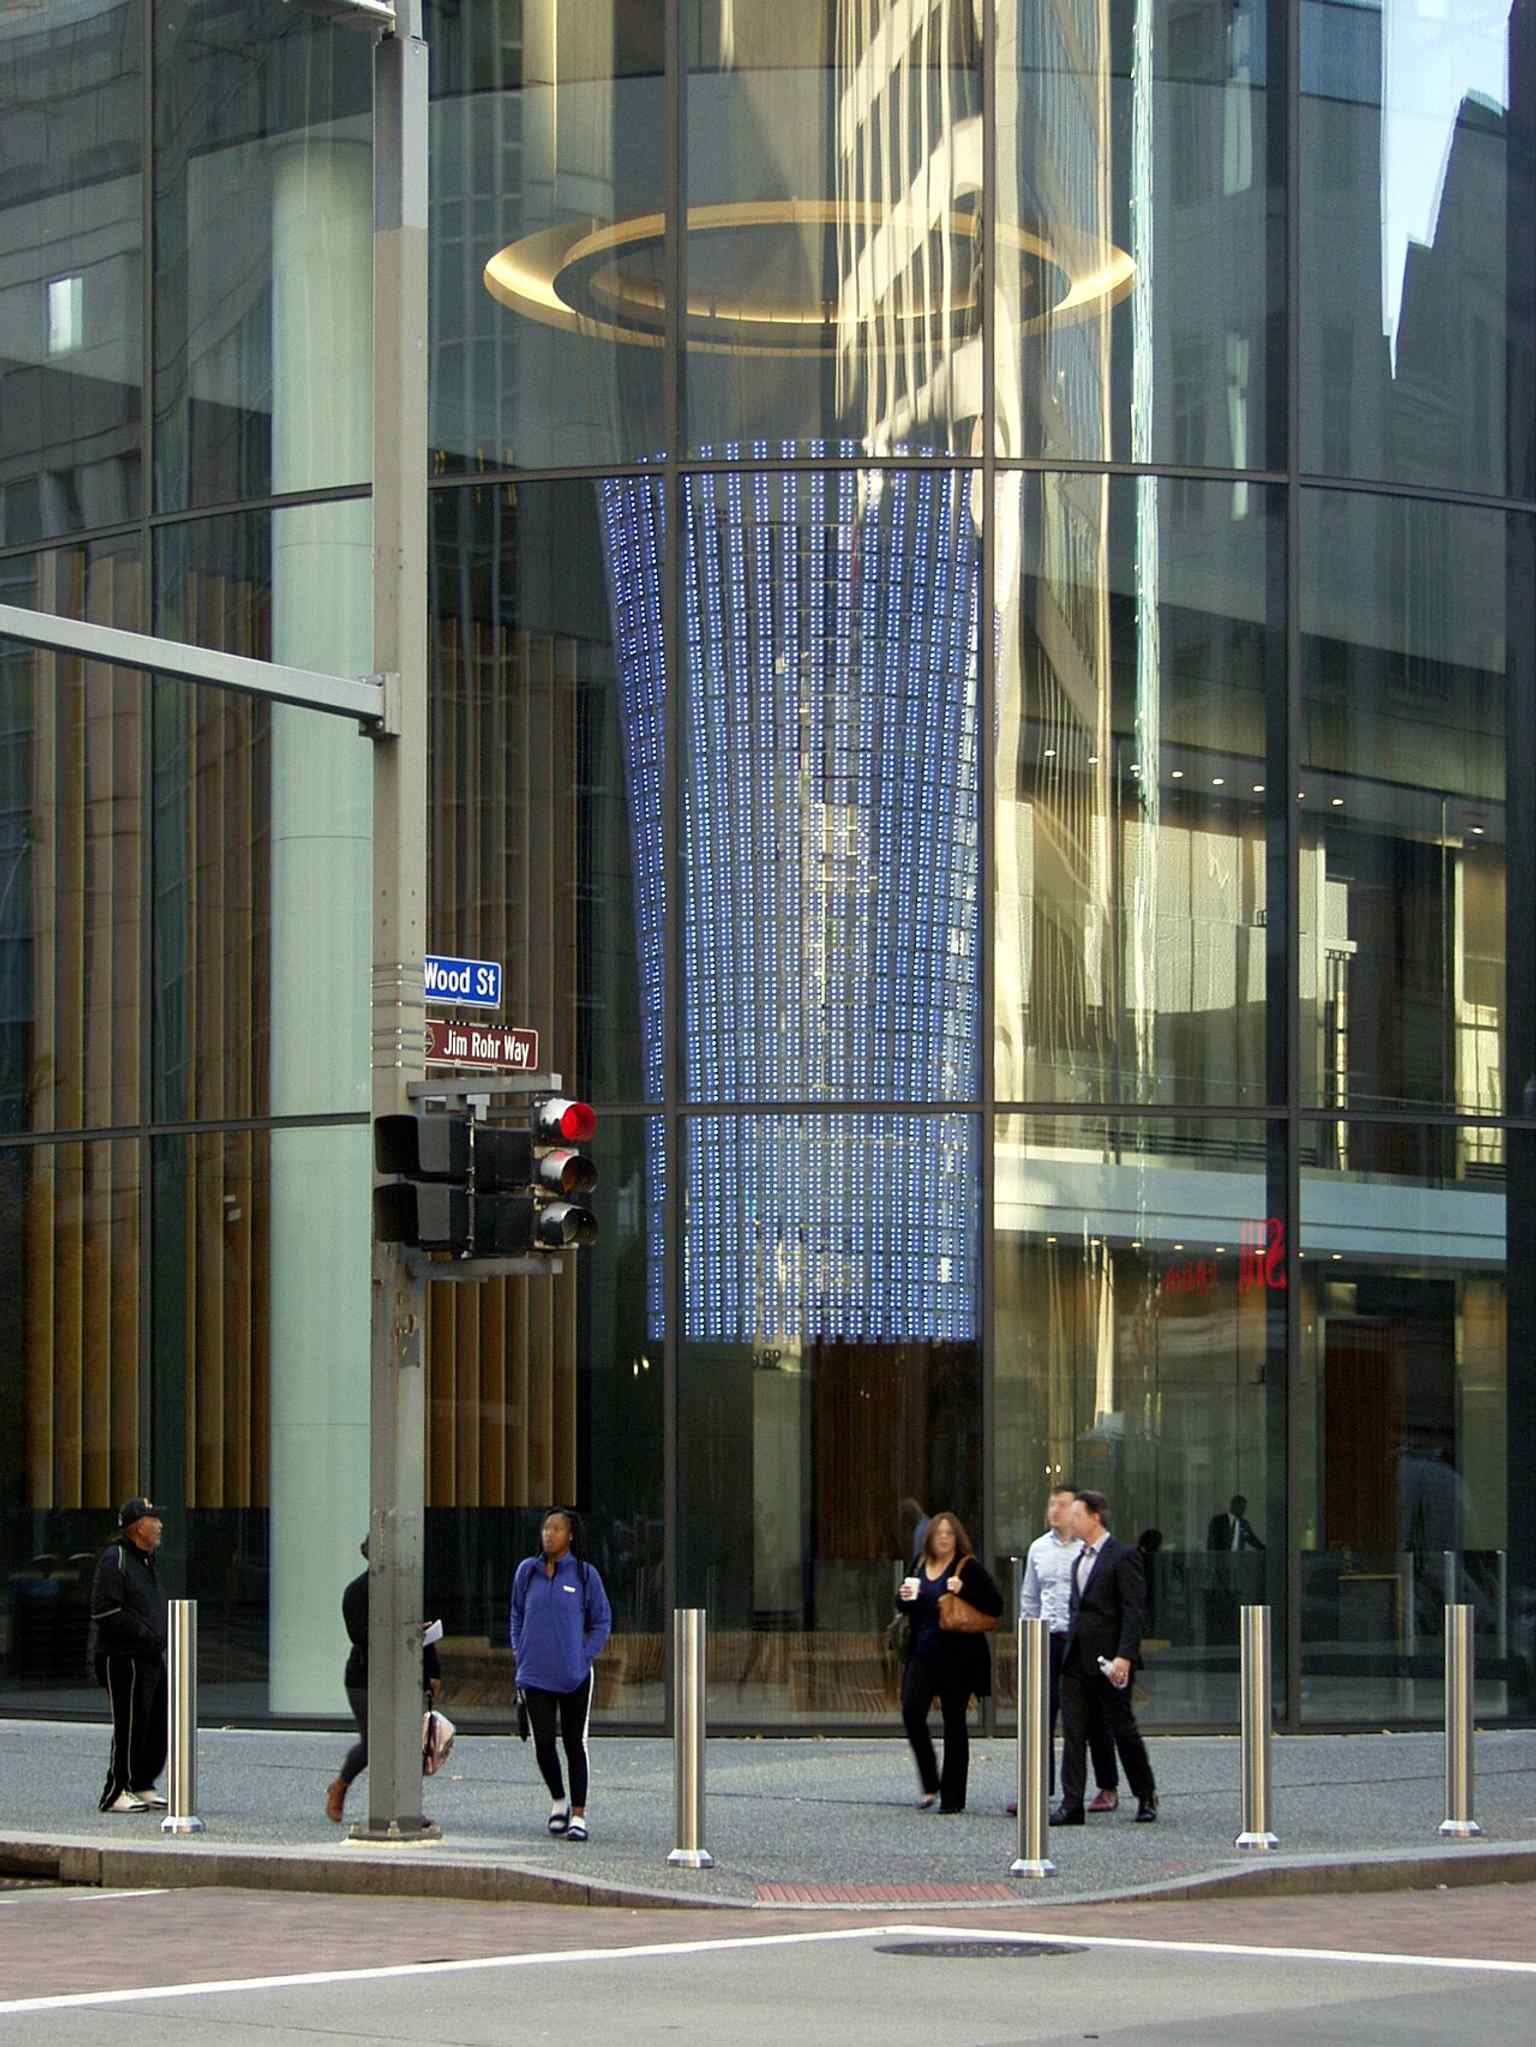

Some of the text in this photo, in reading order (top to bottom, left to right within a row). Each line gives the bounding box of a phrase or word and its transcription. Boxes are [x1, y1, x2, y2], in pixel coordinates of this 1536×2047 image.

[424, 962, 496, 996] Wood St
[443, 1029, 529, 1069] Jim Rohr Way
